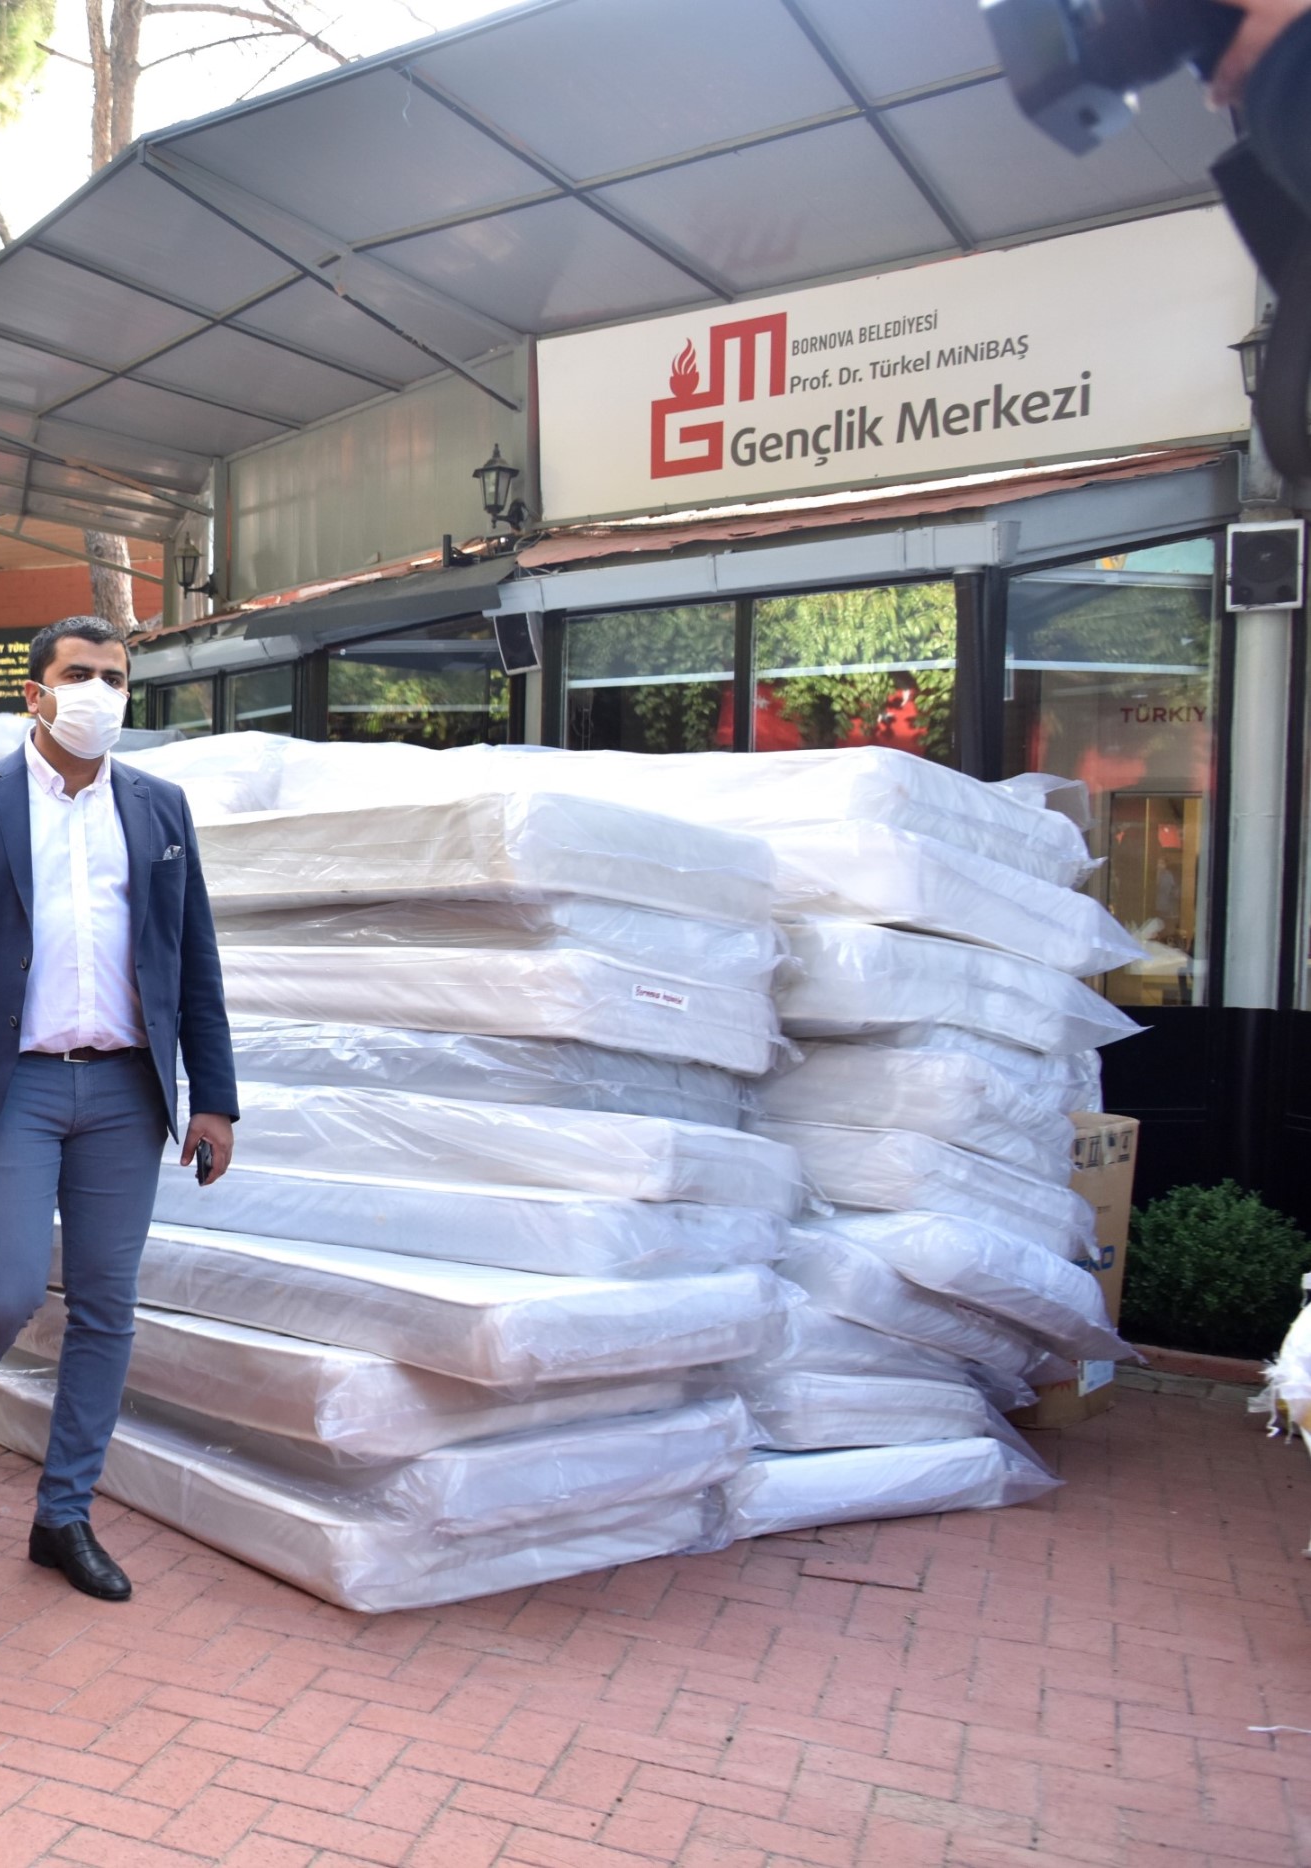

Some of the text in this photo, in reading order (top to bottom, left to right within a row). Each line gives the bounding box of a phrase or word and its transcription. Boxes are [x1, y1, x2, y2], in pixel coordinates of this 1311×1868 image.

[791, 309, 938, 356] BORNOVA BELEDİYESİ
[790, 368, 833, 394] Prof.
[838, 367, 863, 386] Dr.
[869, 351, 931, 380] Türkel
[730, 370, 1092, 467] Gençlik Merkezi
